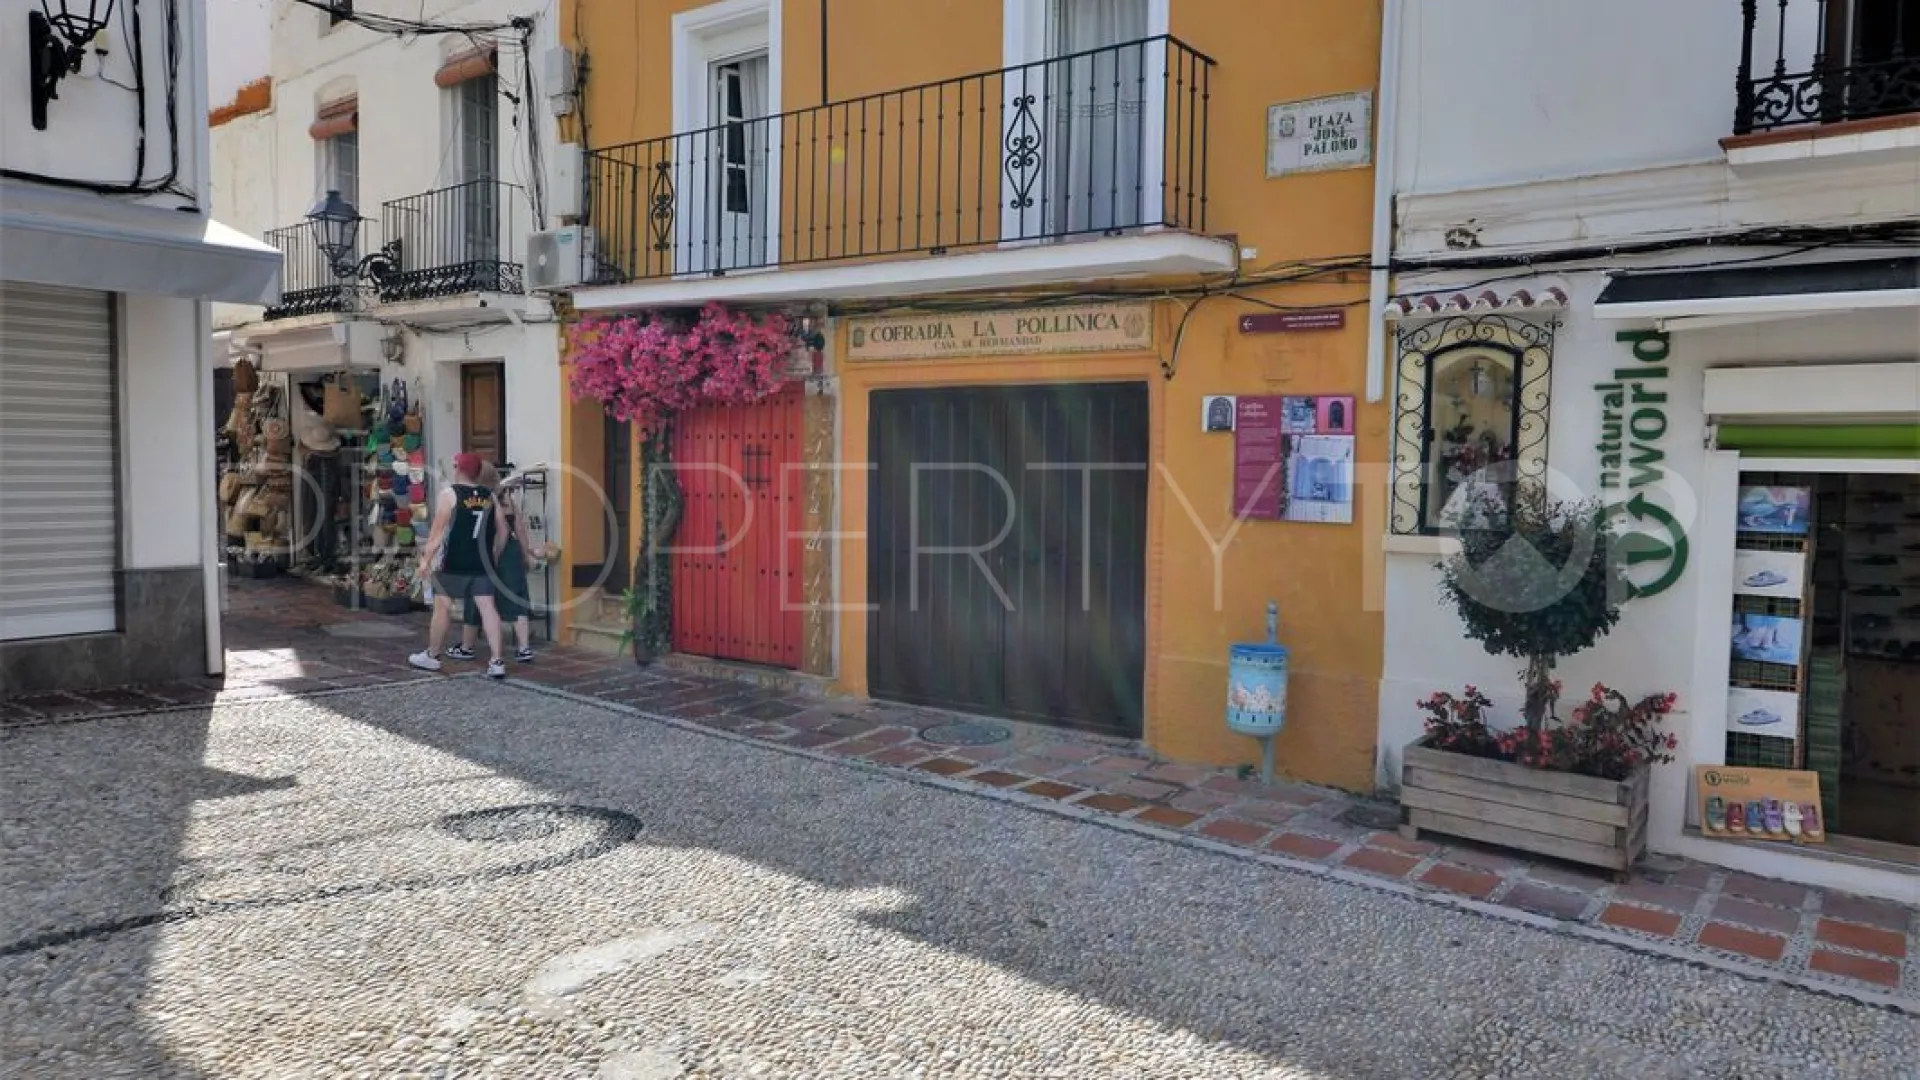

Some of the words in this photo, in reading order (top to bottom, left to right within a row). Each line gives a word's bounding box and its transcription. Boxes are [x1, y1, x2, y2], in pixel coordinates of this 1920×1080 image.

[1309, 112, 1354, 129] PLAZA
[1304, 137, 1358, 156] PALOMO
[973, 320, 997, 337] LA
[1016, 312, 1119, 335] POLLINICA
[1614, 328, 1671, 489] world
[1593, 382, 1625, 489] natural
[472, 510, 485, 539] 7
